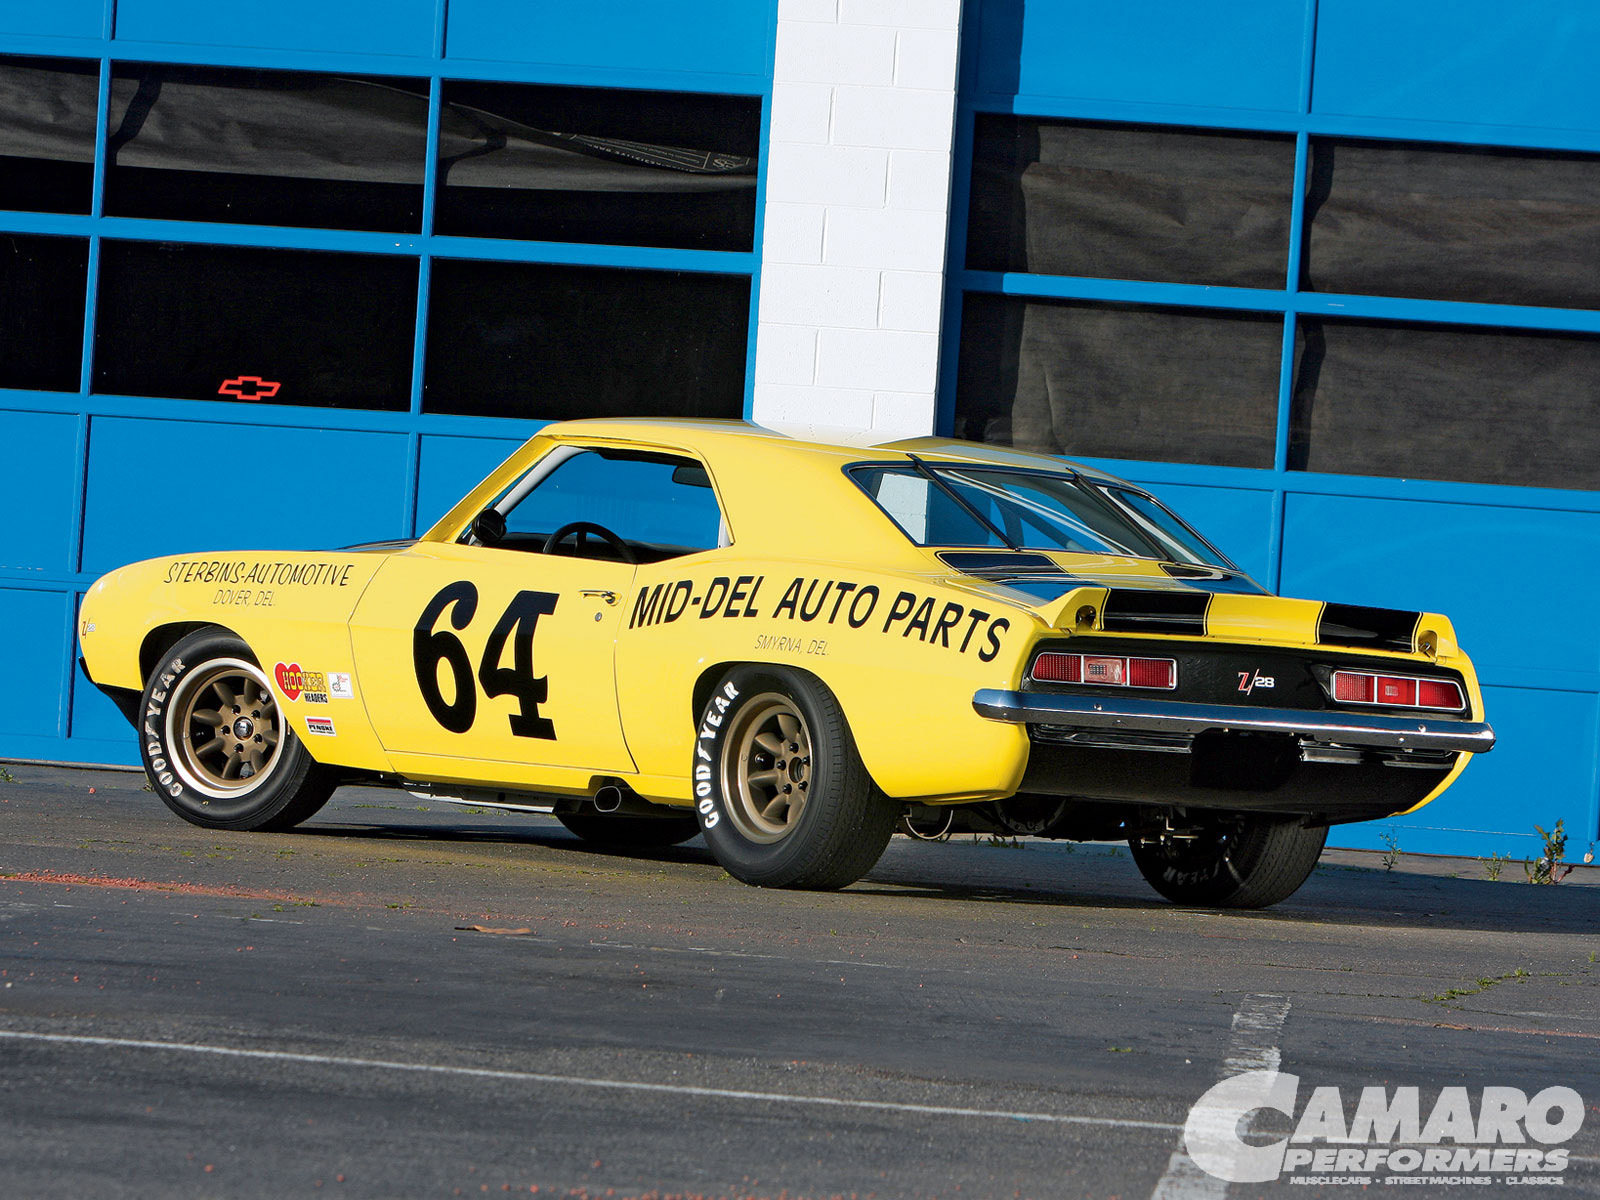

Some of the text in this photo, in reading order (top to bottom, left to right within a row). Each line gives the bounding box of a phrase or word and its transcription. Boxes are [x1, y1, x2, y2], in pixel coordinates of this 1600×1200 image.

[163, 561, 354, 587] STERBINS-AUTOMOTIVE
[212, 589, 250, 606] DOVER,
[628, 575, 1011, 663] MID-DEL AUTO PARTS
[754, 634, 804, 654] SMYRNA,
[412, 580, 560, 741] 64
[282, 671, 326, 693] HOOKER
[1238, 668, 1275, 696] Z/28
[304, 692, 329, 704] HEADERS
